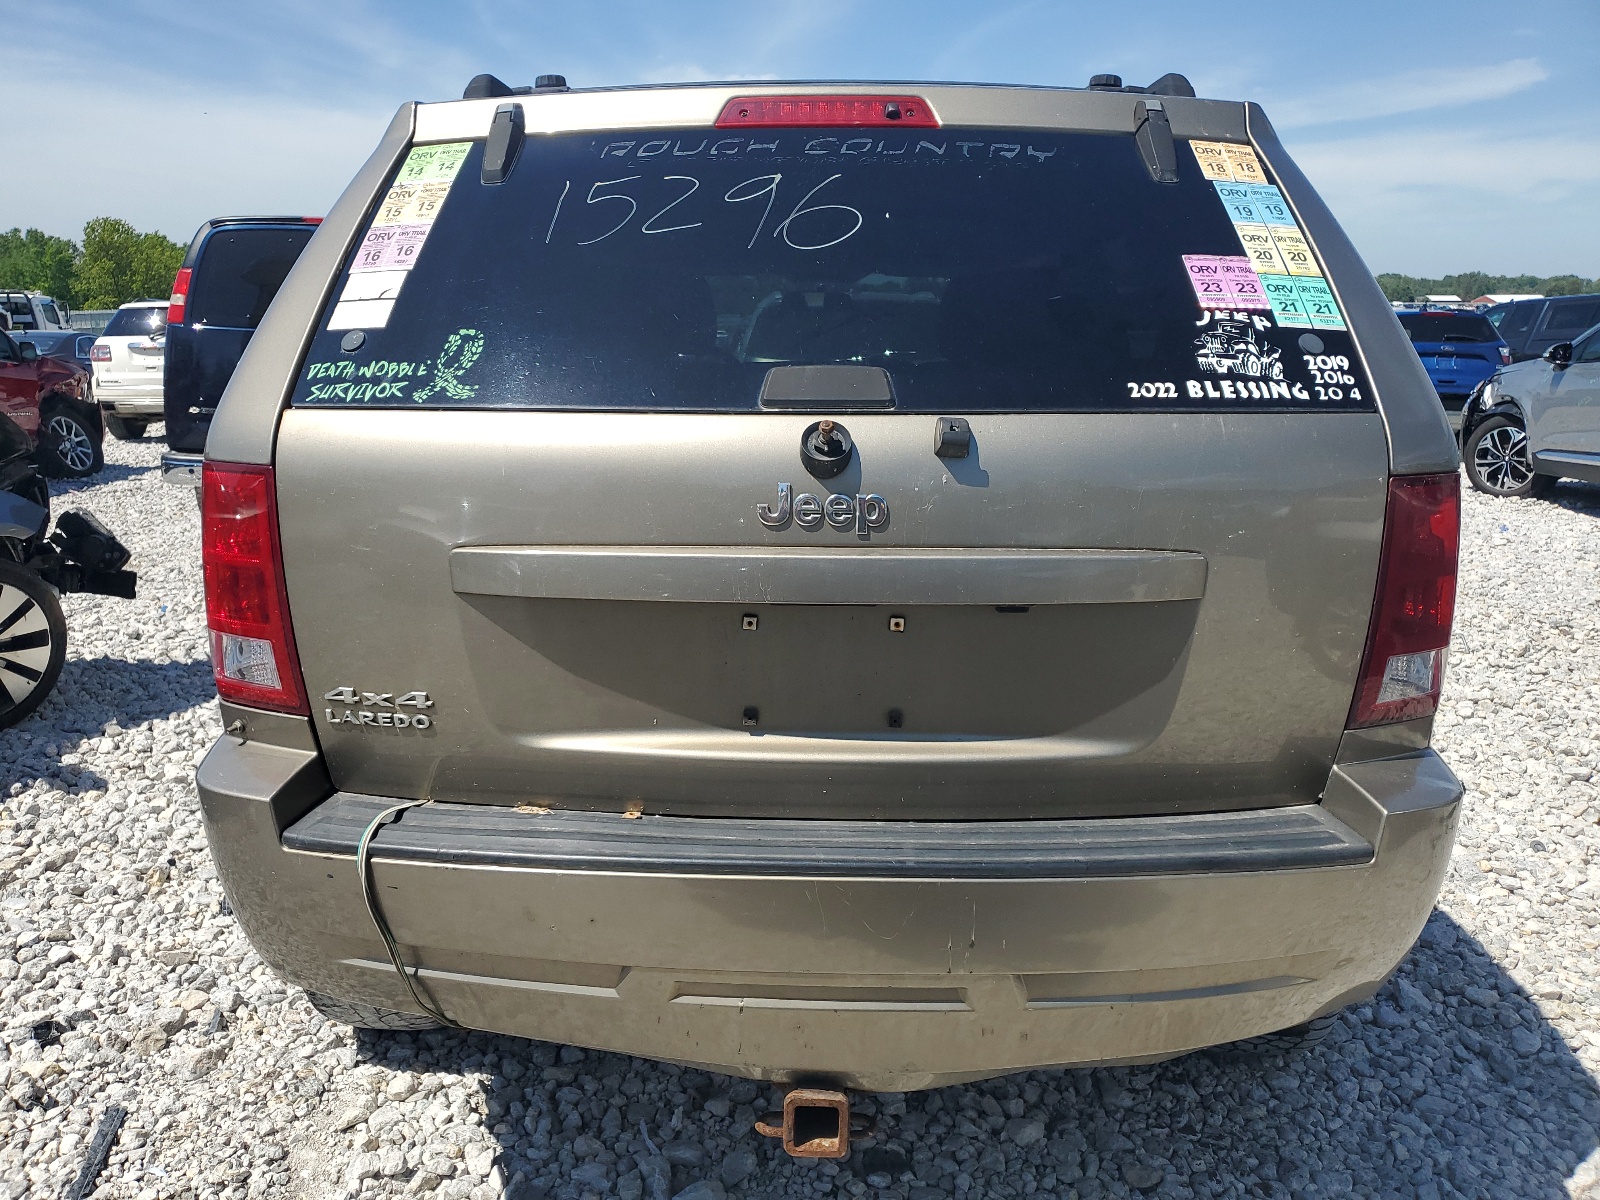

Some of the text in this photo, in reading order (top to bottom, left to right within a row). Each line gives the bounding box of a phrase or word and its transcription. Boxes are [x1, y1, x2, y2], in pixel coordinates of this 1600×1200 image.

[410, 151, 438, 160] ORV
[1195, 146, 1222, 156] ORV
[1207, 163, 1226, 172] 18
[1237, 163, 1255, 172] 18
[388, 190, 417, 200] ORV
[1220, 188, 1248, 198] ORV
[419, 202, 436, 211] 15
[545, 174, 862, 249] 15296
[1234, 206, 1253, 216] 19
[1265, 205, 1284, 215] 19
[386, 208, 403, 217] 15
[367, 232, 396, 242] ORV
[1242, 234, 1268, 243] ORV
[364, 251, 381, 261] 16
[397, 246, 415, 256] 16
[1254, 250, 1273, 260] 20
[1287, 252, 1307, 262] 20
[1190, 265, 1217, 274] ORV
[1200, 282, 1223, 293] 23
[1235, 282, 1258, 293] 23
[1266, 284, 1293, 294] ORV
[1279, 301, 1298, 313] 21
[1312, 303, 1333, 314] 21
[1303, 354, 1349, 370] 2019
[307, 361, 356, 380] DEATH
[306, 381, 409, 402] SURVIVOR
[1127, 380, 1310, 400] 2022 BLESSING
[757, 482, 888, 535] Jeep
[325, 708, 430, 729] LAREDO
